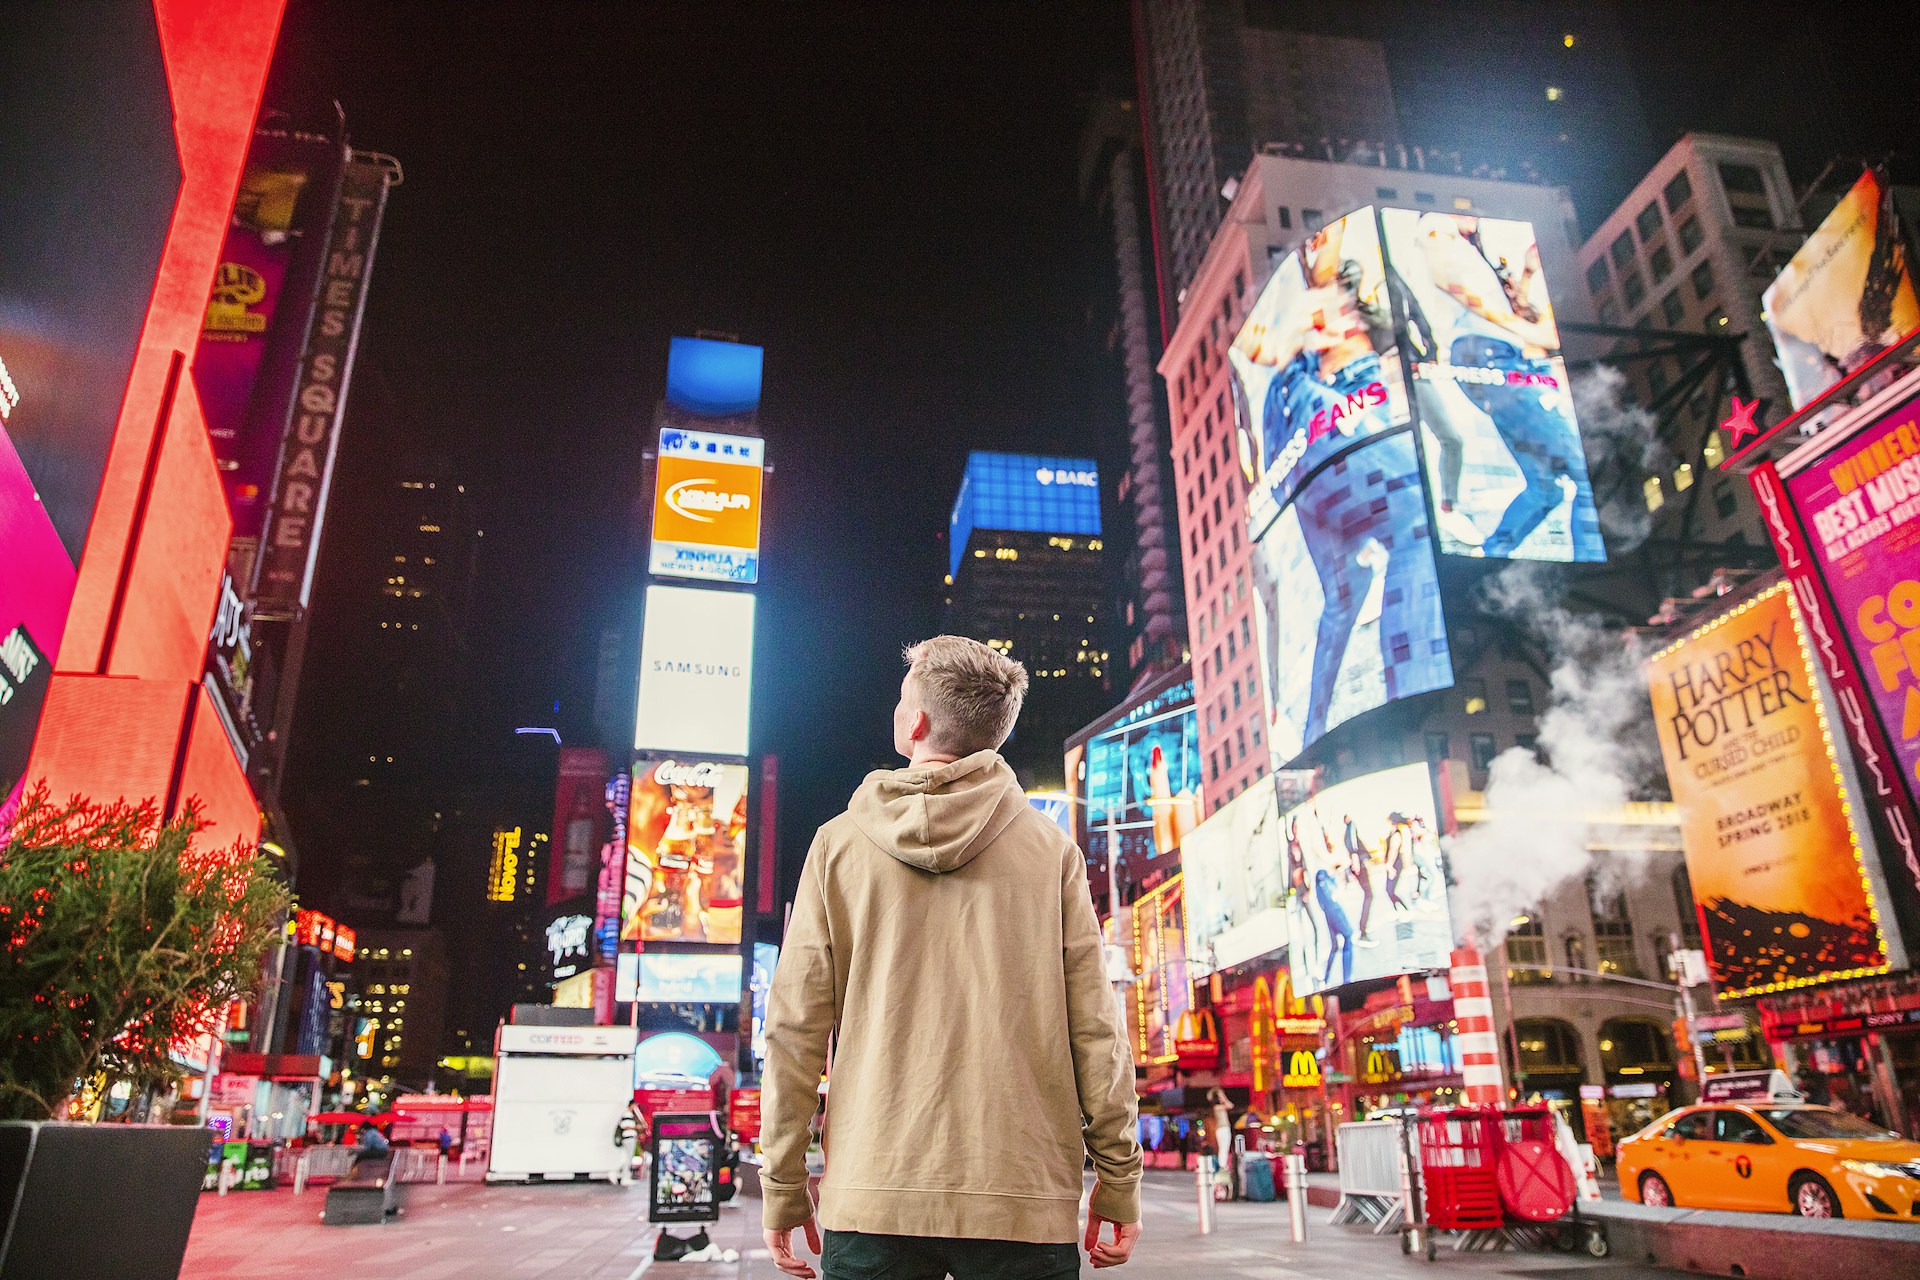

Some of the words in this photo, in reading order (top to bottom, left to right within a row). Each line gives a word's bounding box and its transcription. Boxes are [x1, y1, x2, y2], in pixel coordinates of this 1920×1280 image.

[319, 196, 372, 338] TIMES
[1307, 381, 1388, 446] JEANS
[275, 354, 337, 549] SQUARE
[1055, 470, 1099, 487] BARC
[1812, 488, 1869, 546] BEST
[675, 549, 733, 567] XINHUA
[653, 660, 741, 677] SAMSUNG
[1668, 619, 1780, 714] HARRY
[1671, 669, 1808, 760] POTTER
[1693, 746, 1750, 779] CURSED
[1751, 724, 1801, 757] CHILD
[1716, 791, 1801, 831] BROADWAY
[1718, 820, 1772, 849] SPRING
[1777, 806, 1810, 830] 2018
[498, 826, 521, 901] NOVOTEL
[1867, 1011, 1904, 1027] SONY
